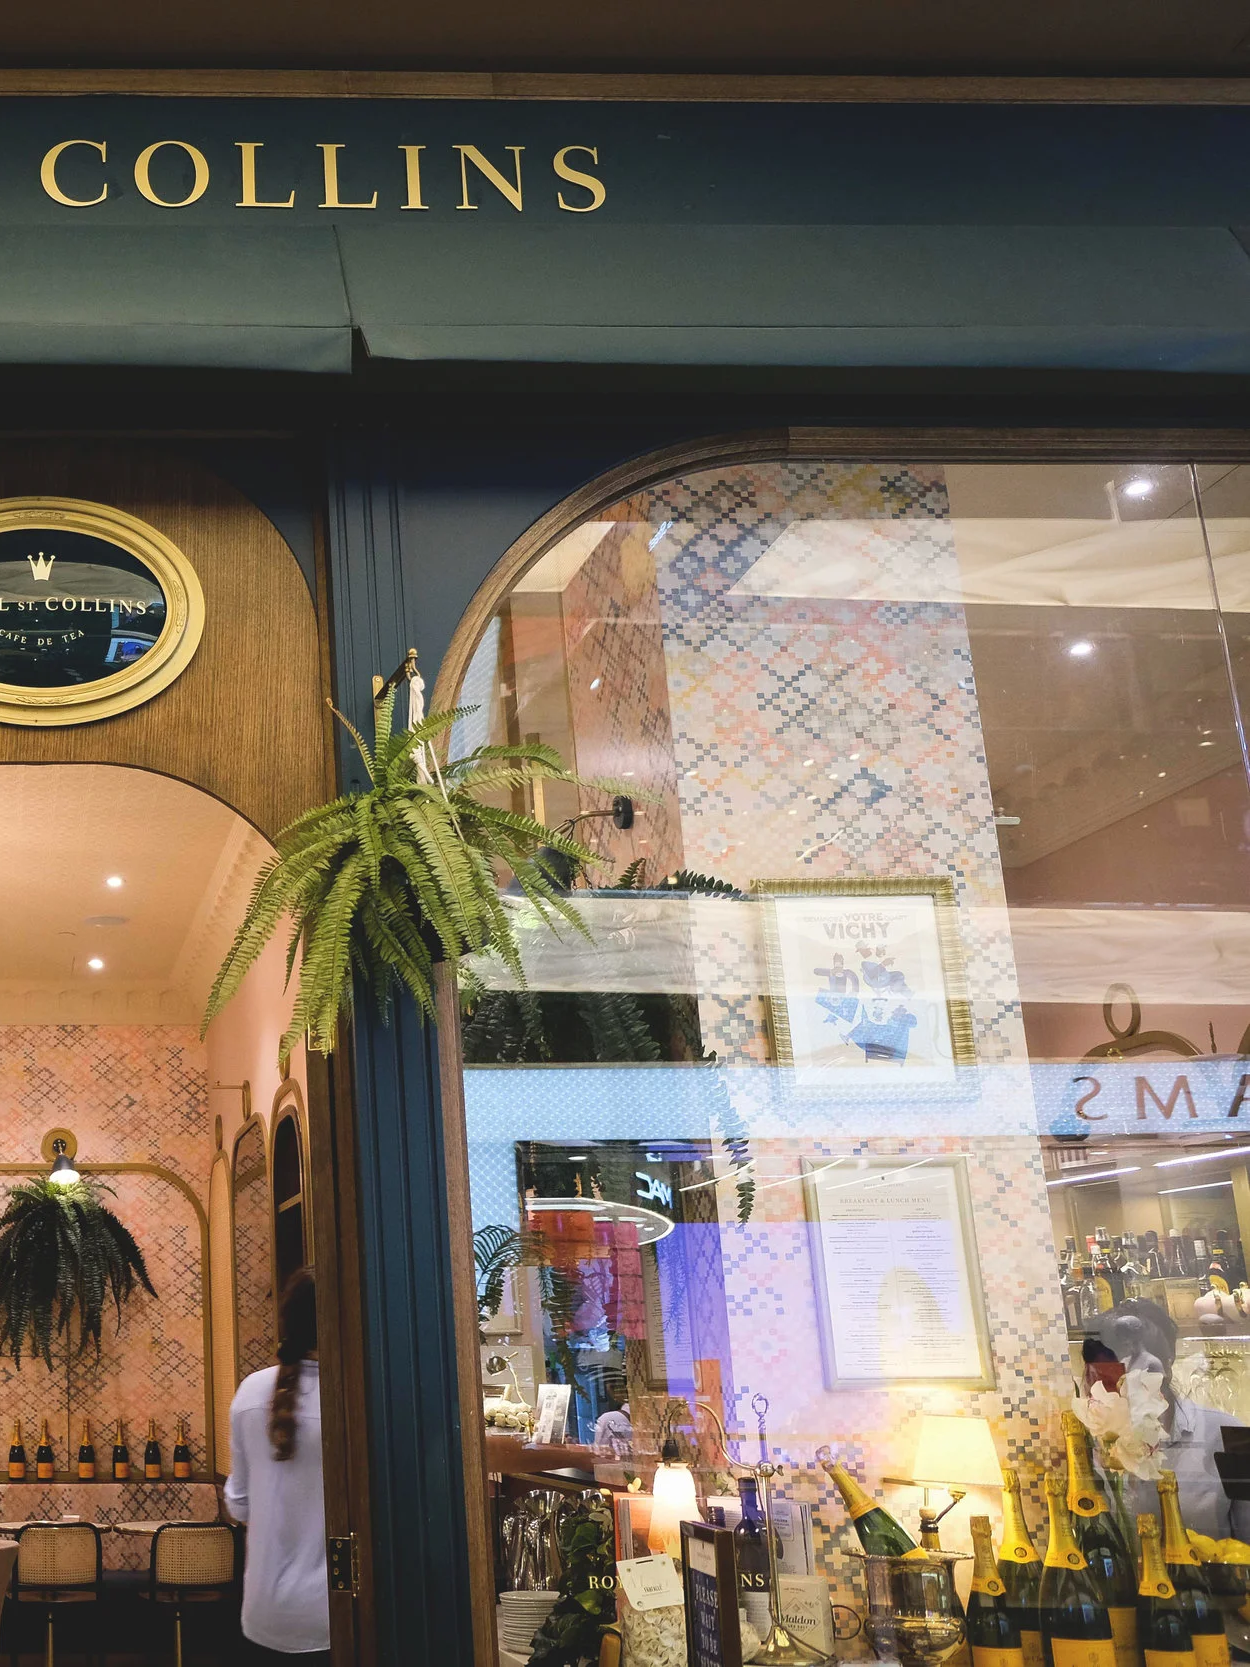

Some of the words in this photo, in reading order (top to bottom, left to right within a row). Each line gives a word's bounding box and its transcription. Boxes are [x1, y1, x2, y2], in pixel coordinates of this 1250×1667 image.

[39, 139, 607, 213] COLLINS
[17, 600, 38, 611] ST.
[45, 596, 147, 615] COLLINS
[37, 637, 53, 646] DE
[62, 629, 85, 644] TEA
[843, 912, 883, 922] VOTRE
[823, 922, 891, 940] VICHY
[588, 1575, 624, 1590] ROY
[695, 1583, 719, 1609] PLEASE
[700, 1610, 715, 1631] WAIT
[781, 1614, 816, 1626] Maldon
